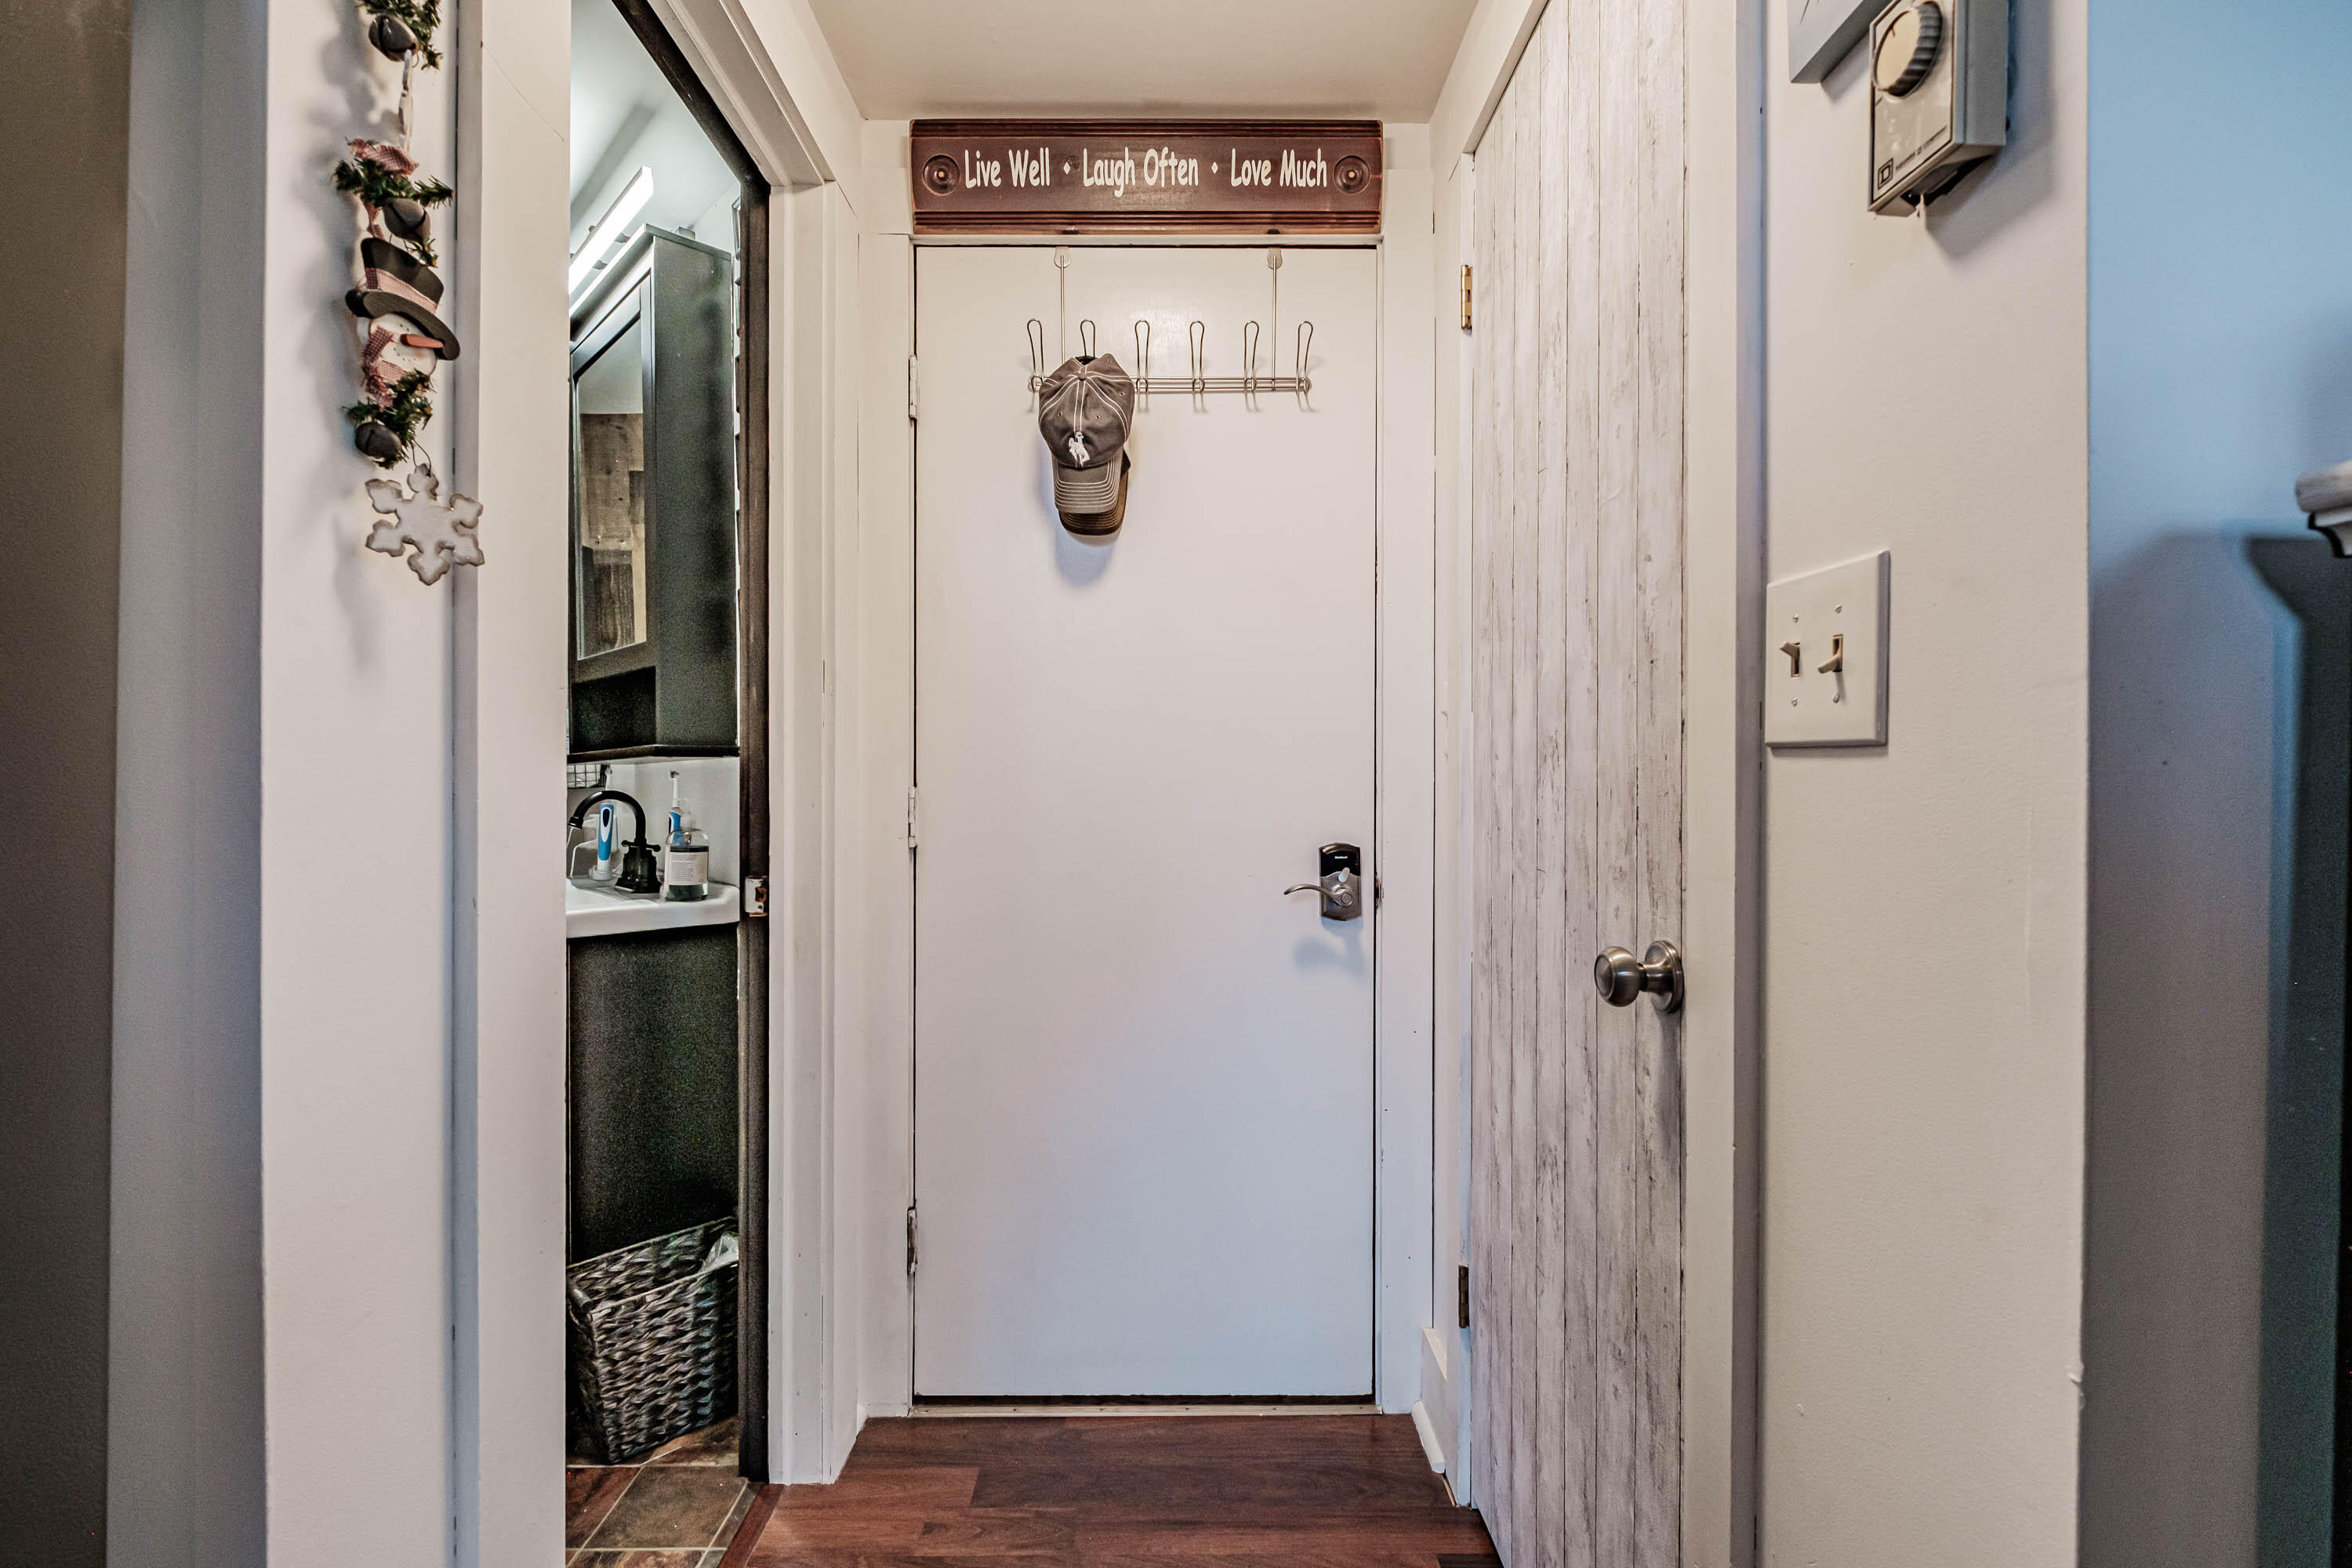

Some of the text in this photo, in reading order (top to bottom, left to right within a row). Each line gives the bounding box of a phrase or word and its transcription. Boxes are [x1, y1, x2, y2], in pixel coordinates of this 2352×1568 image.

[964, 147, 1327, 198] Live Well Laugh Often Love Much
